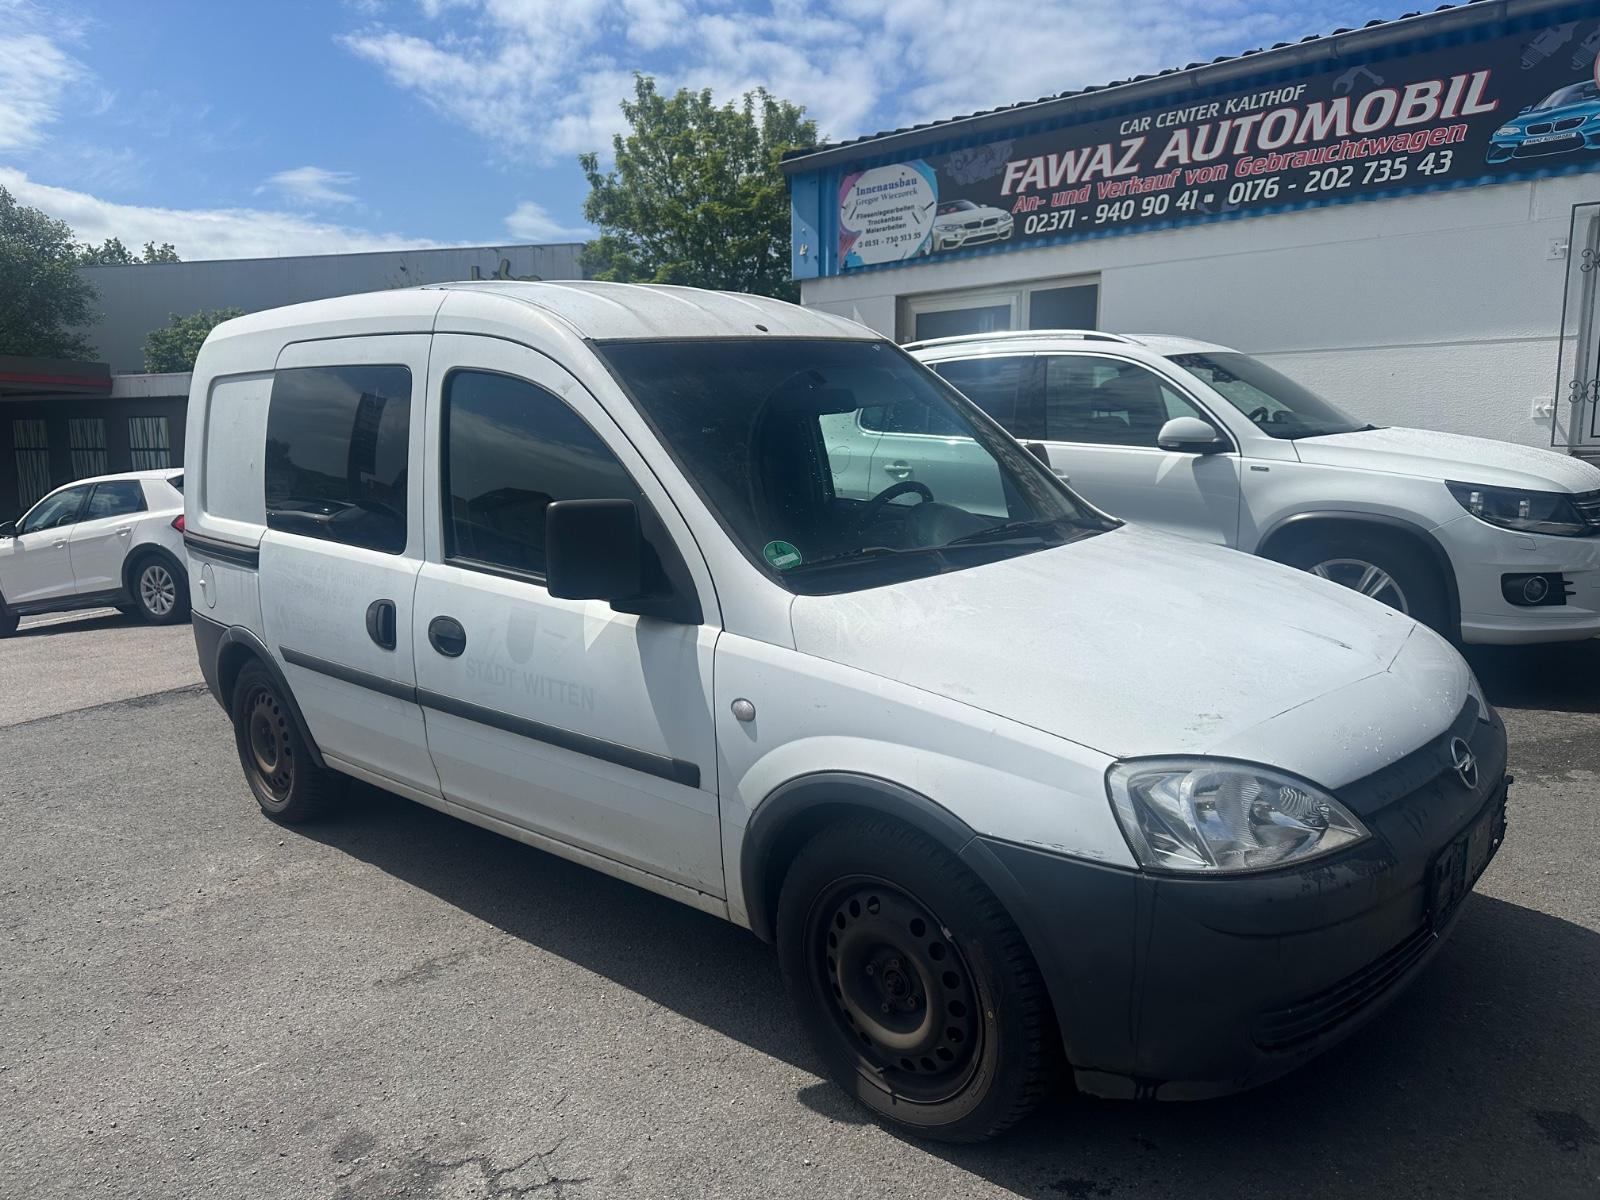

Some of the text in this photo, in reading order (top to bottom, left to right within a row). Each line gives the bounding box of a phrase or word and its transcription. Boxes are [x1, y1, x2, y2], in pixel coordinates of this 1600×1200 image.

[1000, 68, 1499, 195] FAWAZ AUTOMOBIL
[1120, 84, 1307, 136] CAR CENTER KALTHOF
[856, 178, 917, 196] Innenausbau
[1011, 124, 1468, 214] An- und Verkauf von Gebrauchtwagen
[1024, 210, 1076, 235] 02371
[1095, 200, 1135, 224] 940
[1141, 194, 1170, 217] 90
[1175, 190, 1199, 212] 41
[1228, 176, 1280, 205] 0176
[1304, 165, 1354, 193] 202
[1361, 156, 1408, 185] 735
[1417, 150, 1453, 176] 43
[465, 657, 595, 711] STADT WITTEN
